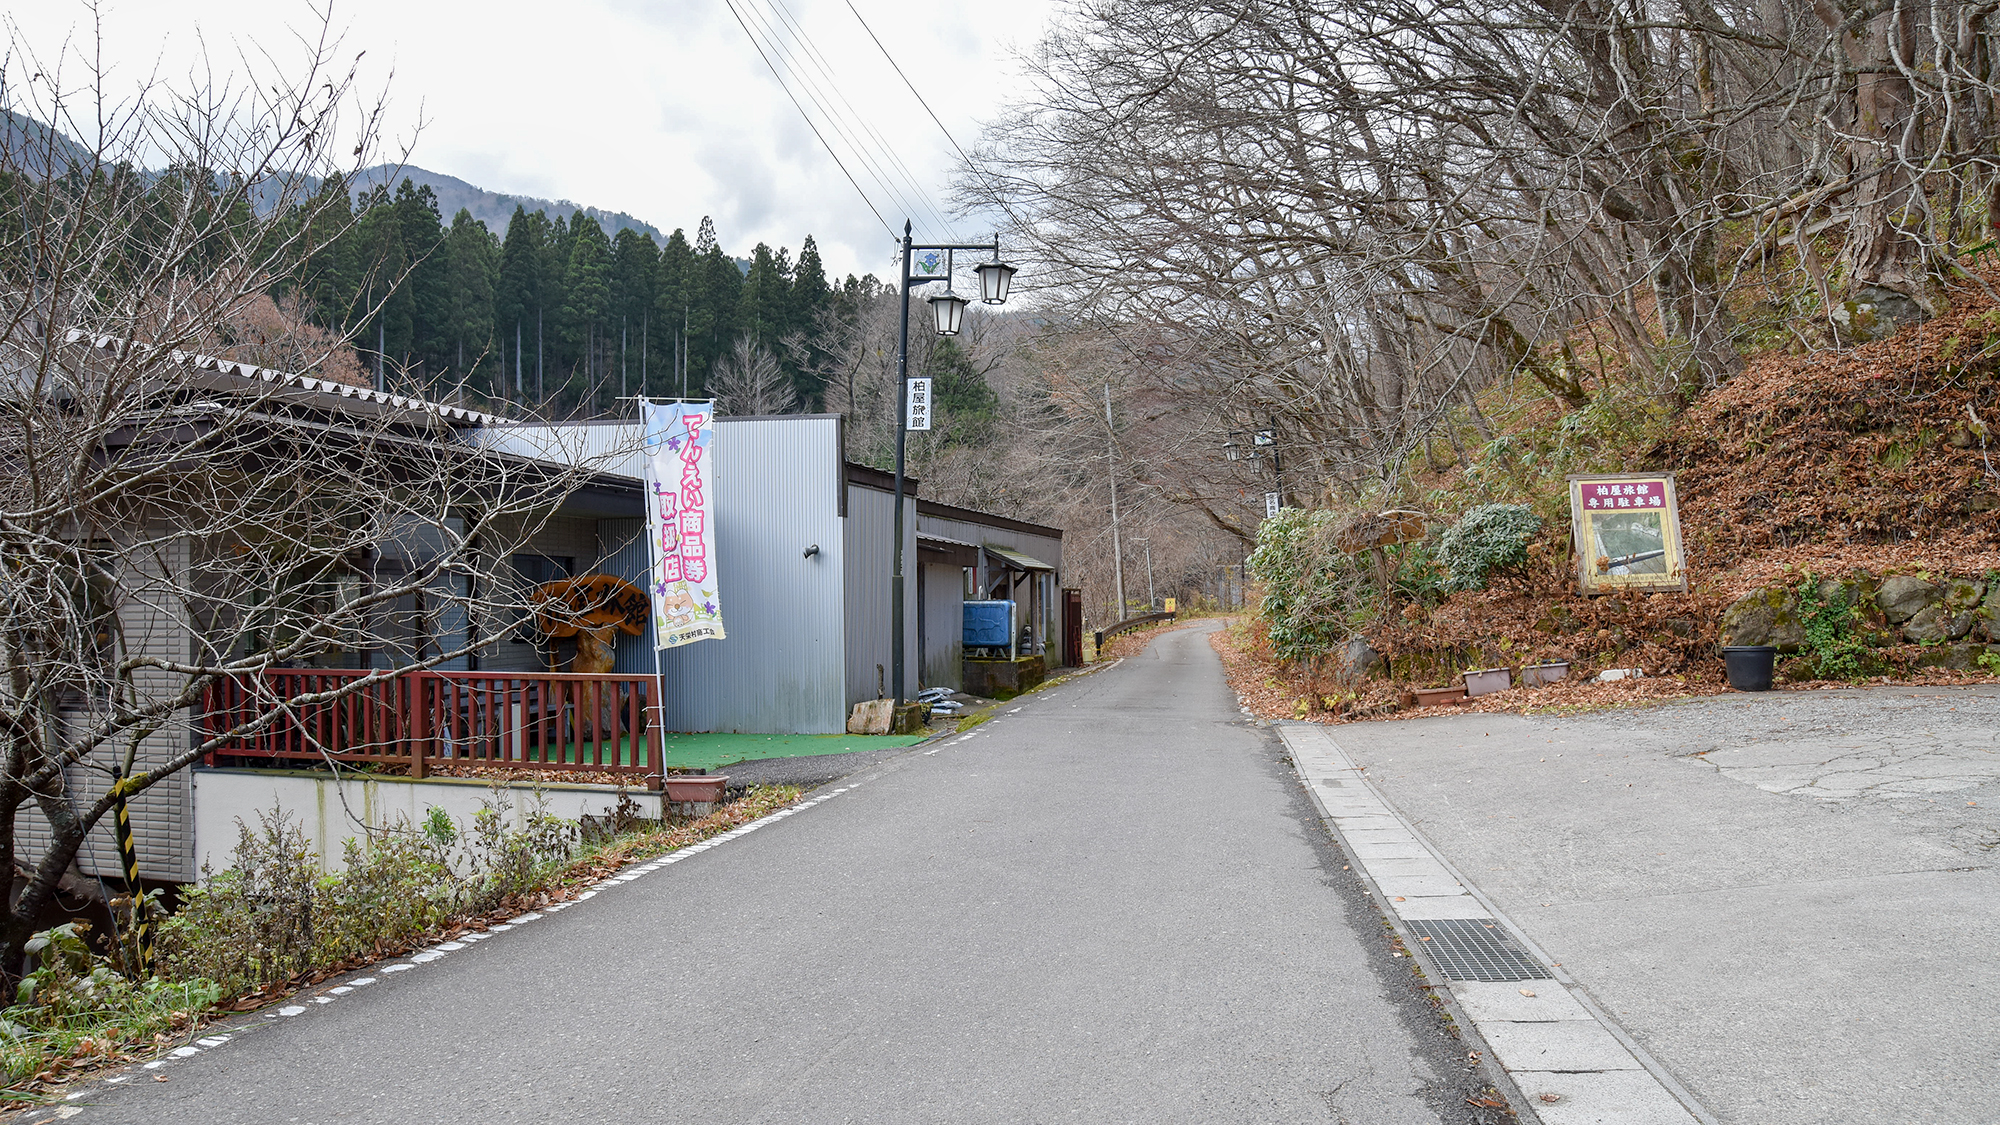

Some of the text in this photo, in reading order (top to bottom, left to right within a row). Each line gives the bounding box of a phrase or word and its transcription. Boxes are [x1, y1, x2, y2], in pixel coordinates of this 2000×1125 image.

[912, 380, 925, 428] 柏屋旅館
[680, 414, 707, 583] てんえい商品券
[1588, 496, 1661, 508] 専用駐車場
[1597, 484, 1649, 496] 柏屋旅館
[659, 492, 682, 583] 取扱店
